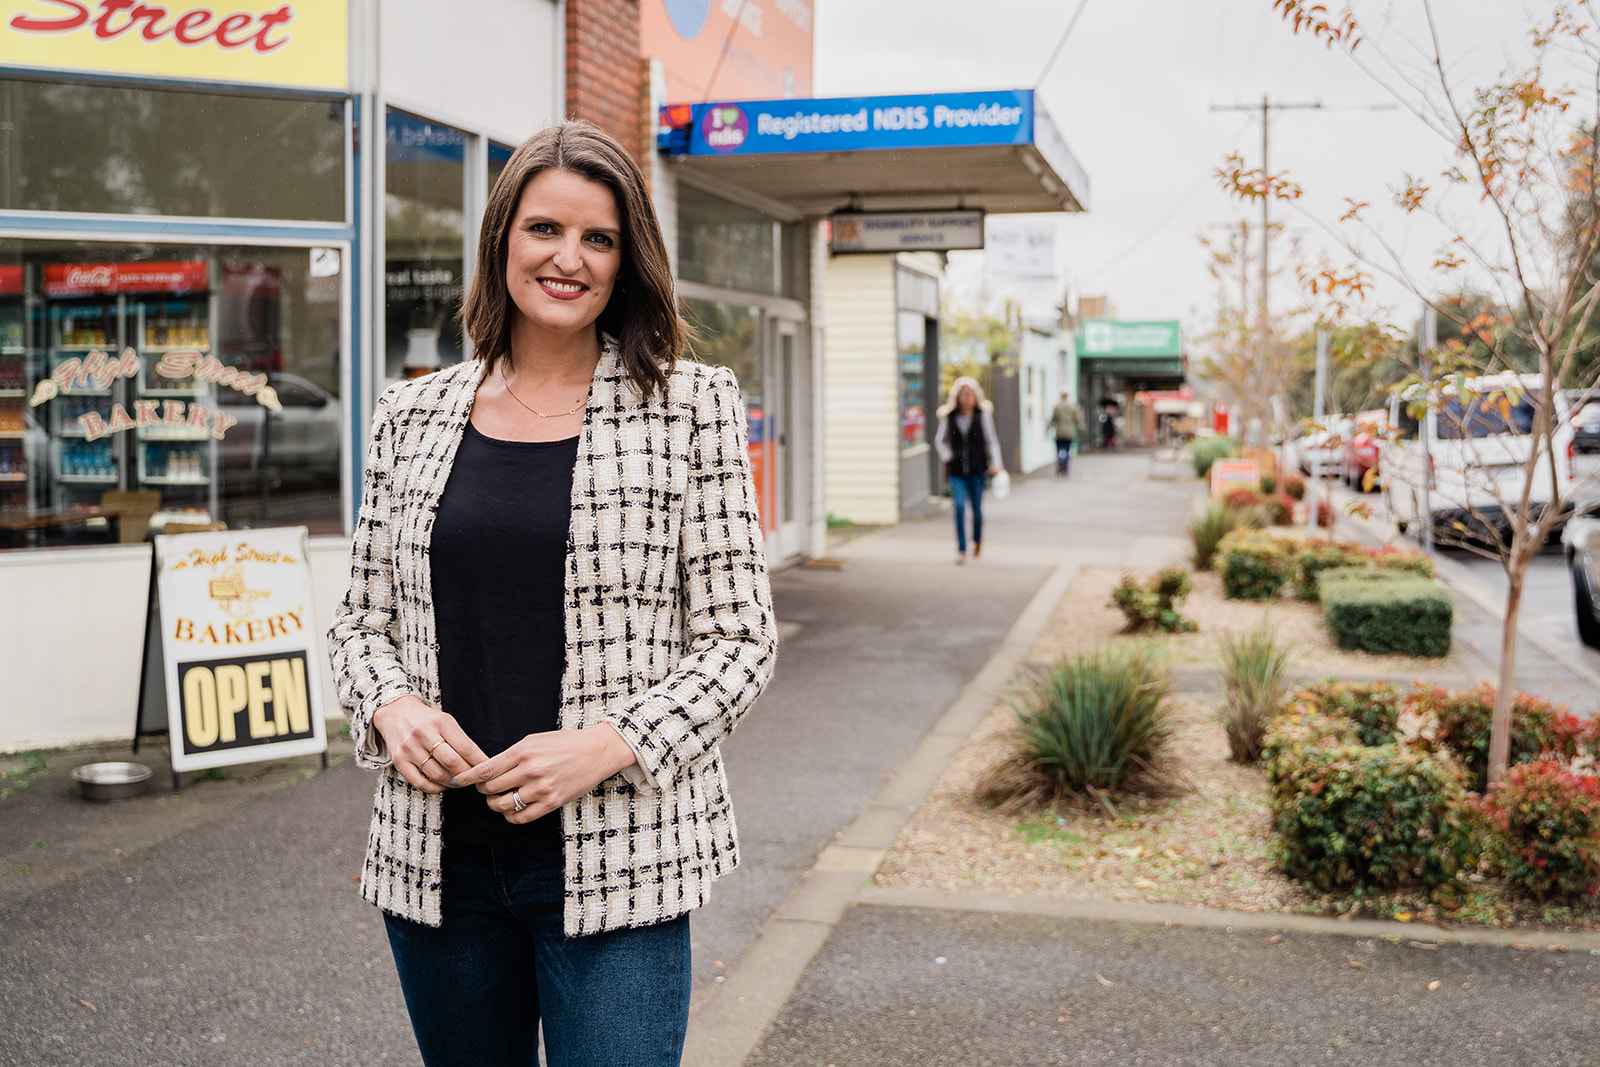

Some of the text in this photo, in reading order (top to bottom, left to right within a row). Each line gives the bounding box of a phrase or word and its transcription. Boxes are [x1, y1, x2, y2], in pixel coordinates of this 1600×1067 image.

[708, 126, 744, 146] ndis
[757, 102, 1023, 140] Registered NDIS Provider
[53, 347, 140, 393] High
[78, 400, 238, 442] BAKERY
[188, 545, 227, 571] High
[173, 606, 304, 644] BAKERY
[183, 657, 310, 747] OPEN
